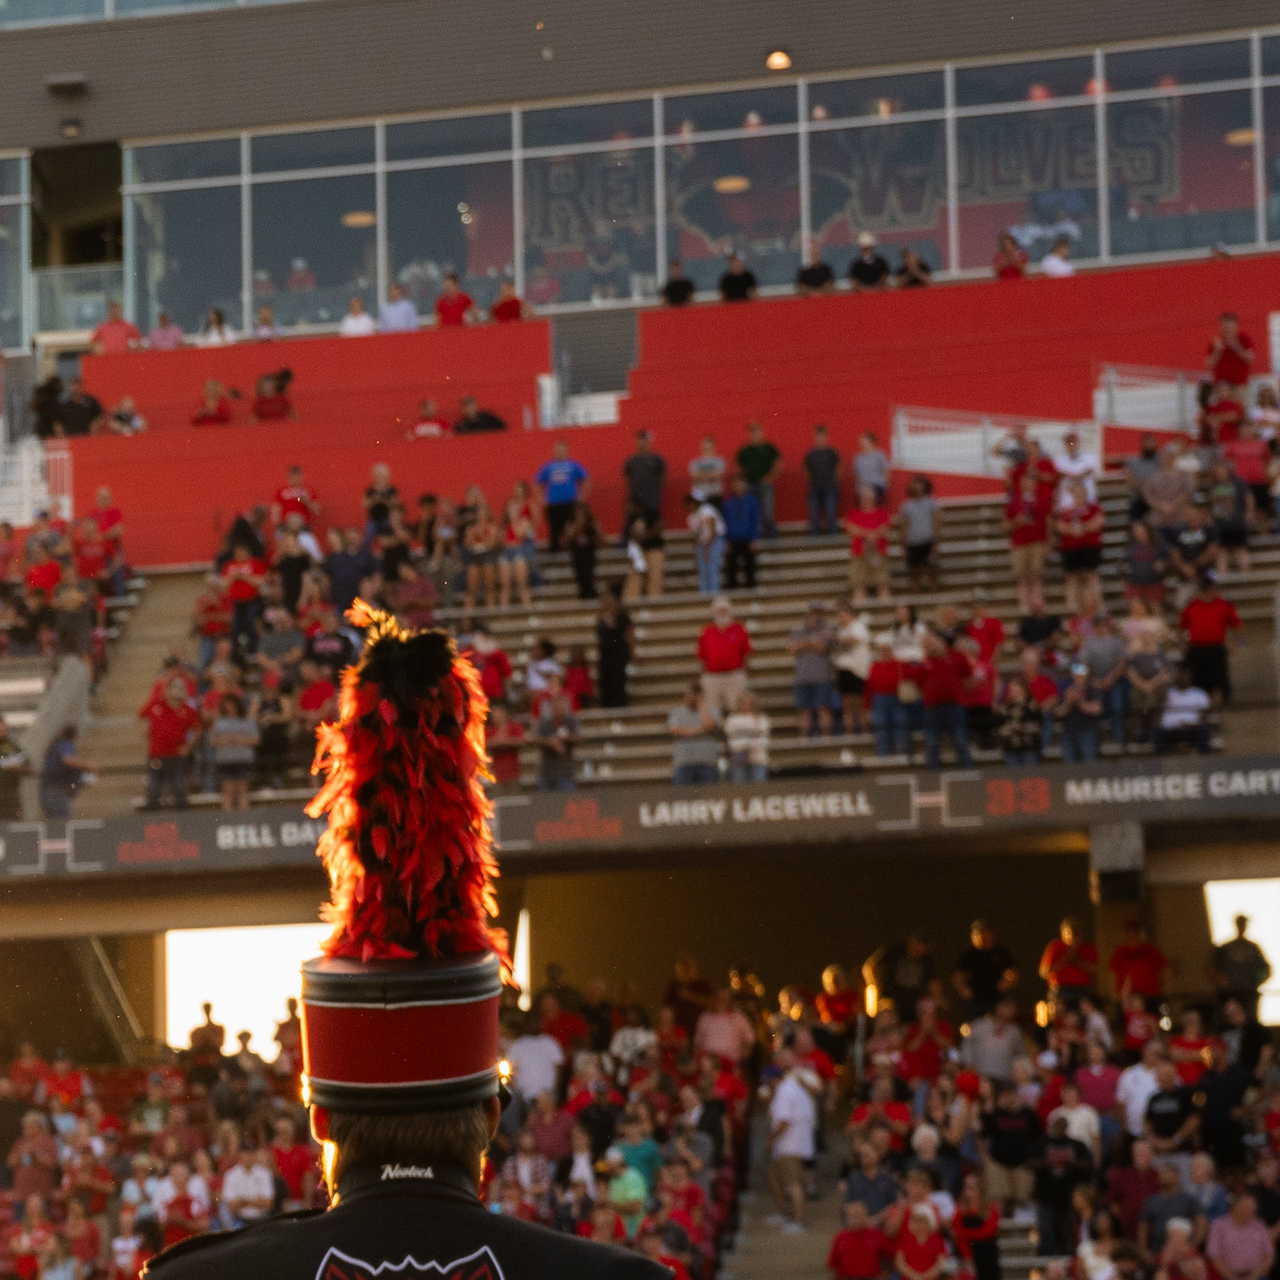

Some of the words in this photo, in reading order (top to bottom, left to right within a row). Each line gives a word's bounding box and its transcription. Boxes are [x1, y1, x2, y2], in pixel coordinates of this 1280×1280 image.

[1065, 774, 1201, 804] MAURICE
[640, 800, 726, 827] LARRY
[732, 791, 874, 822] LACEWELL
[216, 824, 277, 850] BILL
